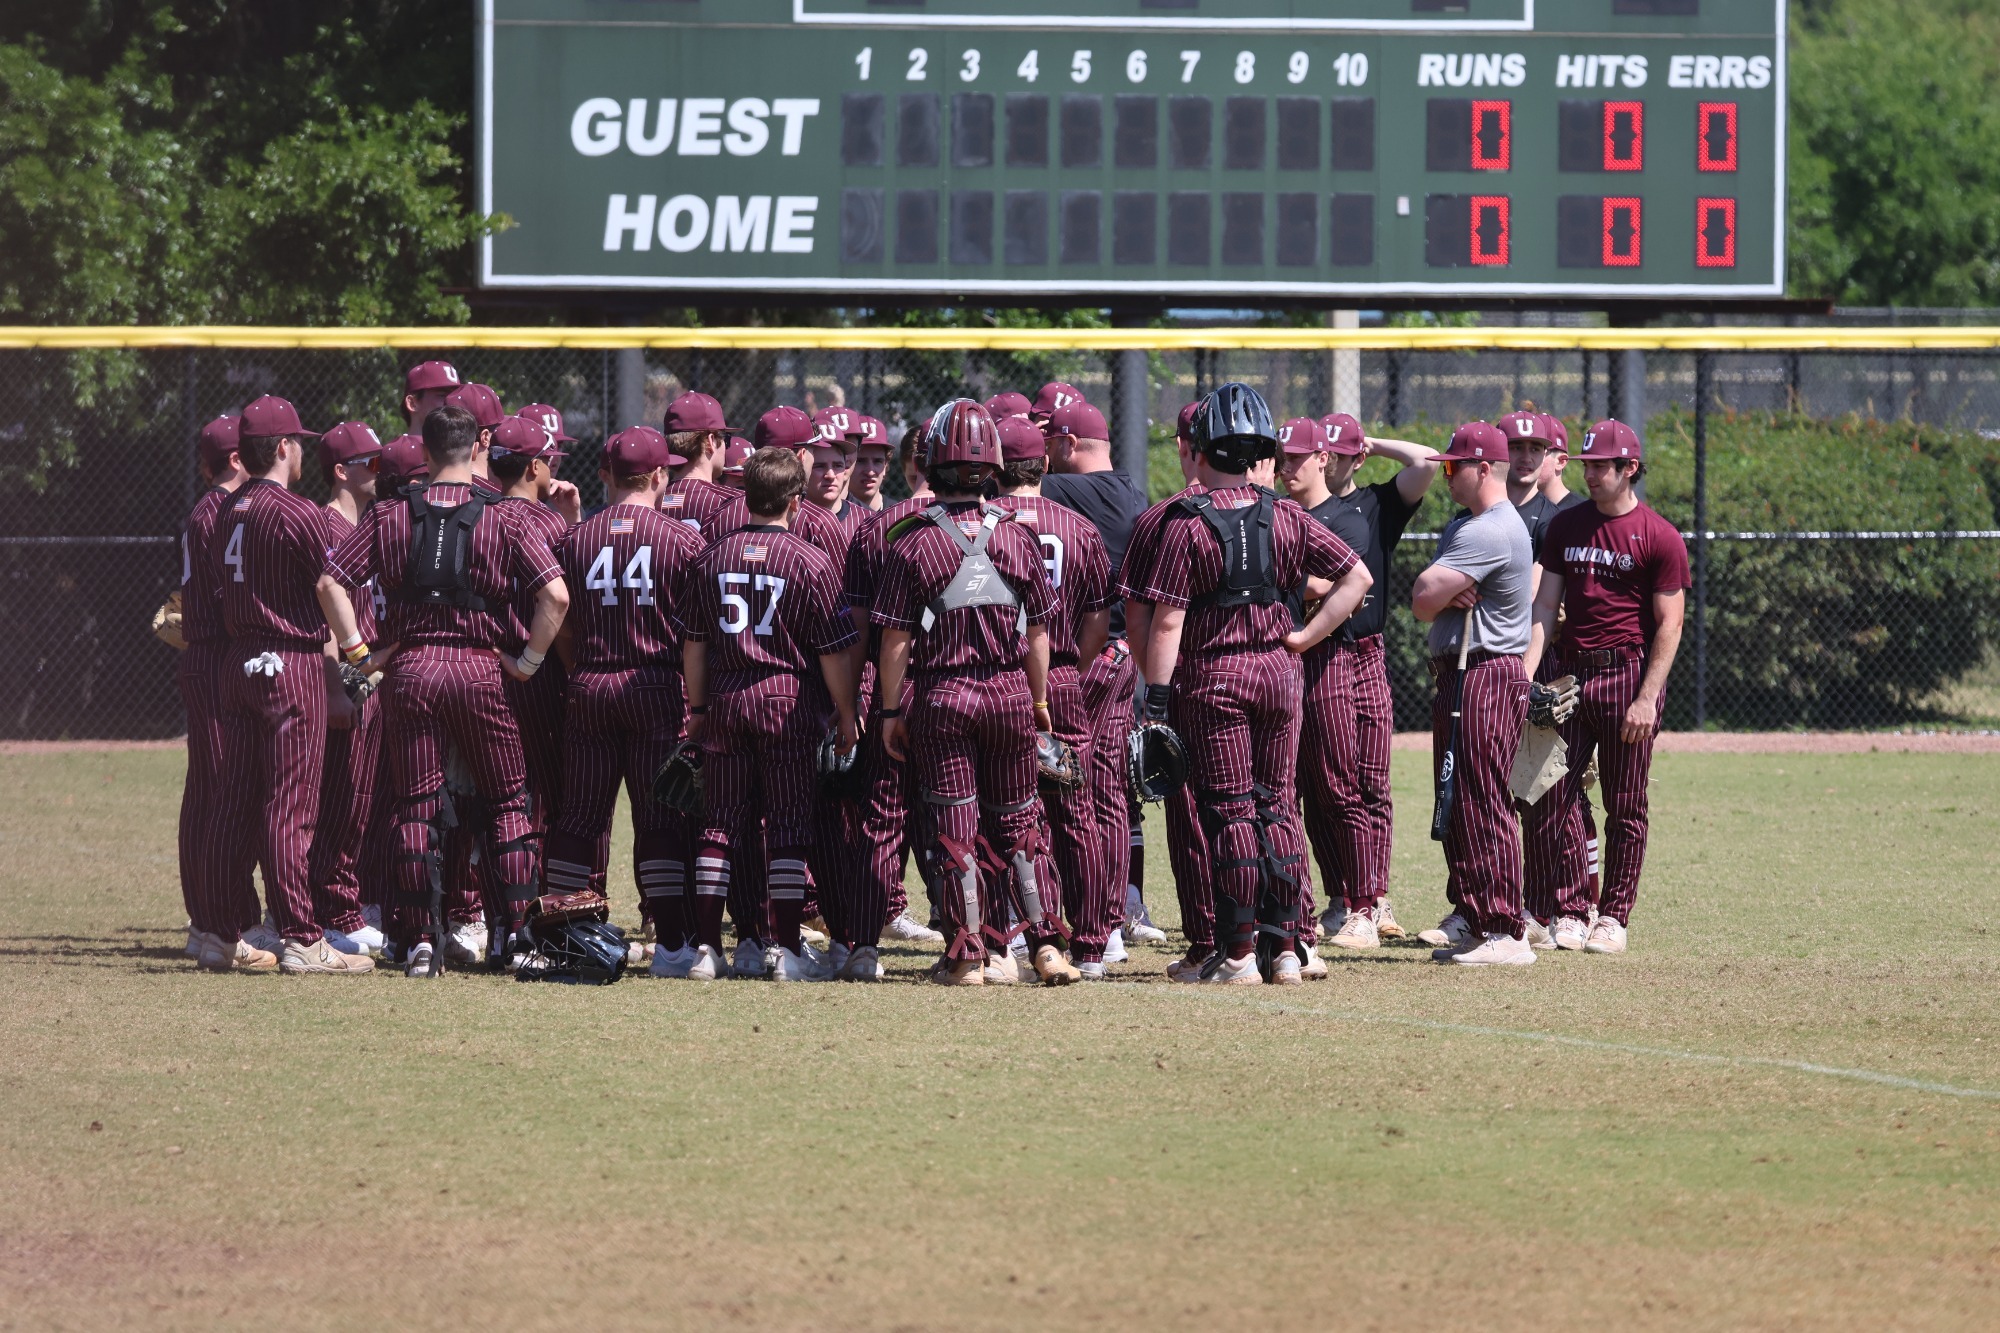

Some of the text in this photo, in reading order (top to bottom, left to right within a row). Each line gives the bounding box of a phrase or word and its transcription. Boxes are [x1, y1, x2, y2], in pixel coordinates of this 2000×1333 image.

[856, 47, 1771, 89] 1 2 3 4 5 6 7 8 9 10 RUNS HITS ERRS
[571, 97, 820, 156] GUEST
[1471, 101, 1736, 171] 0 0 0
[603, 194, 818, 253] HOME
[1470, 196, 1735, 267] 0 0 0
[443, 366, 458, 383] U
[542, 413, 559, 433] U
[832, 413, 850, 430] U
[861, 422, 877, 438] U
[1516, 419, 1533, 437] U
[819, 424, 837, 440] U
[1279, 426, 1294, 443] U
[1326, 424, 1343, 443] U
[1583, 432, 1596, 450] U
[224, 522, 245, 583] 4
[434, 518, 446, 570] EVOSHIELD
[1240, 519, 1248, 571] EVOSHIELD
[1564, 546, 1616, 566] UNION
[586, 545, 654, 606] 44
[1574, 566, 1621, 580] BAEBALL
[718, 573, 785, 636] 57
